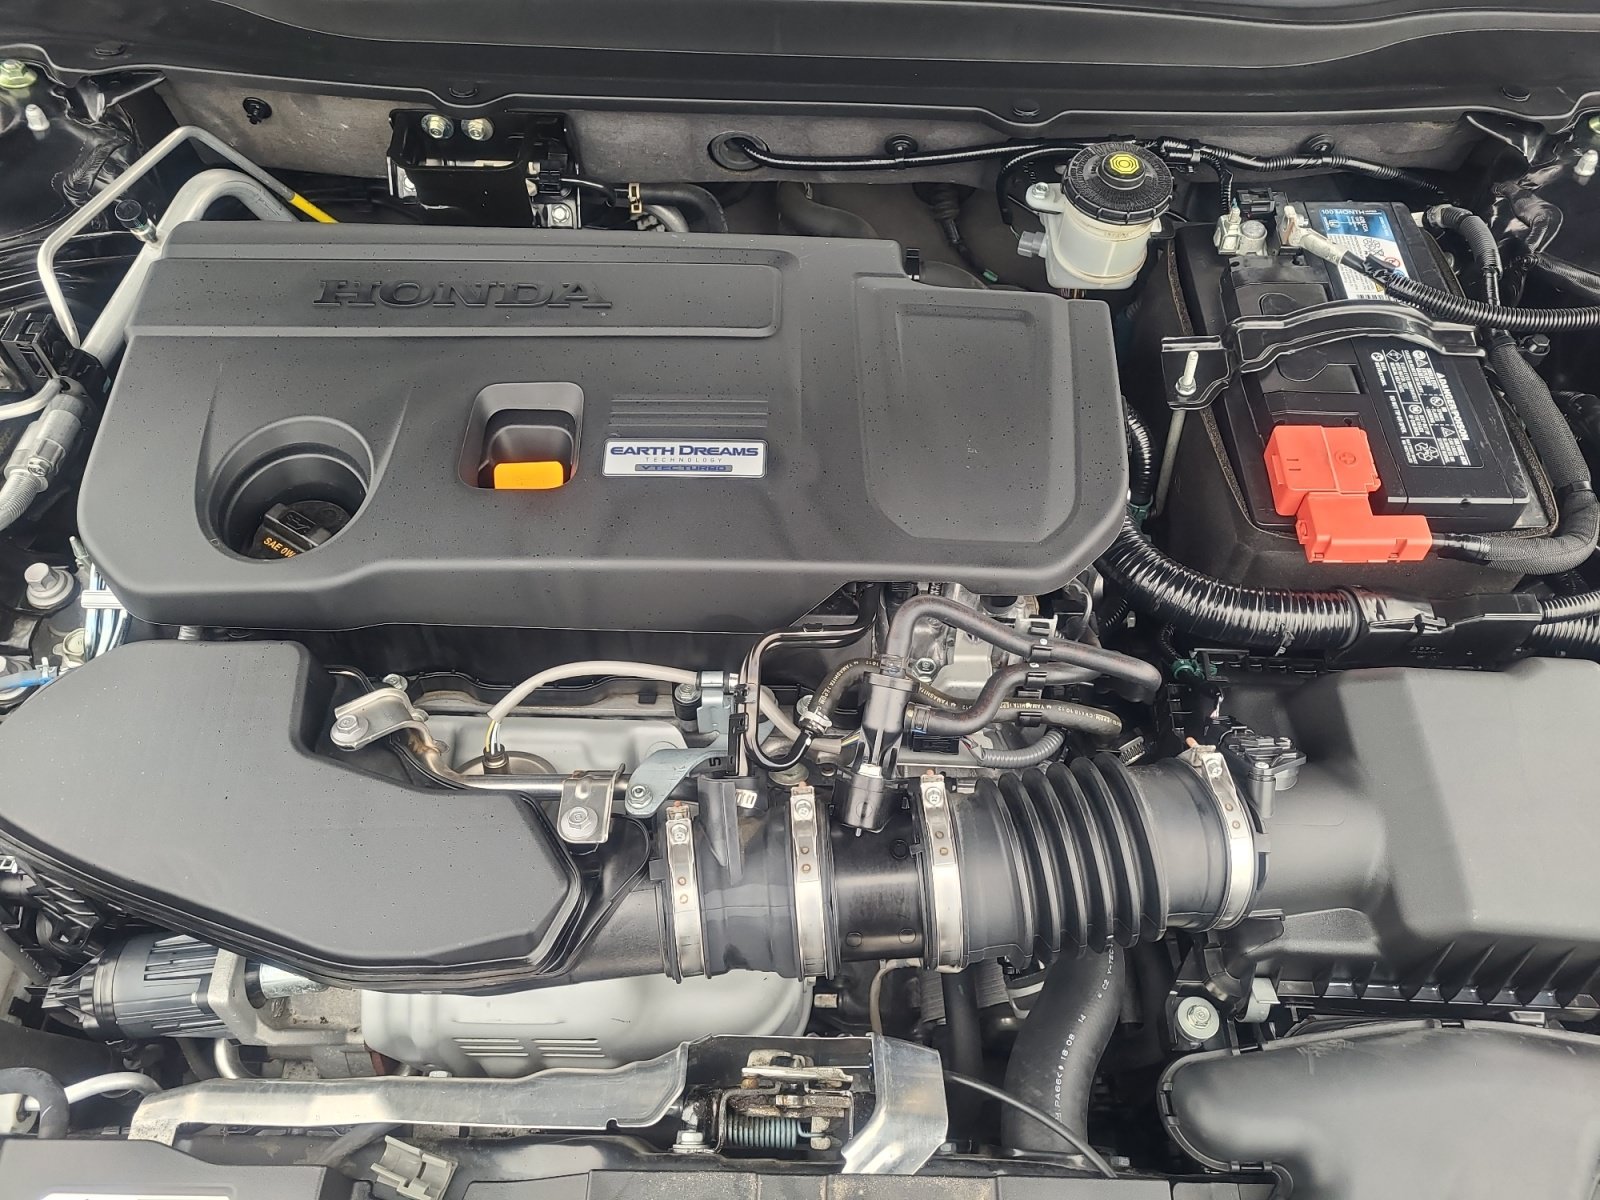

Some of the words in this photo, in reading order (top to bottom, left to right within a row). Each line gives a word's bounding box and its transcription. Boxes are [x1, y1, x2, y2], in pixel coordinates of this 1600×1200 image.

[312, 279, 612, 307] HONDA
[610, 446, 675, 456] EARTH
[679, 445, 759, 456] DREAMS
[263, 537, 283, 552] SAE
